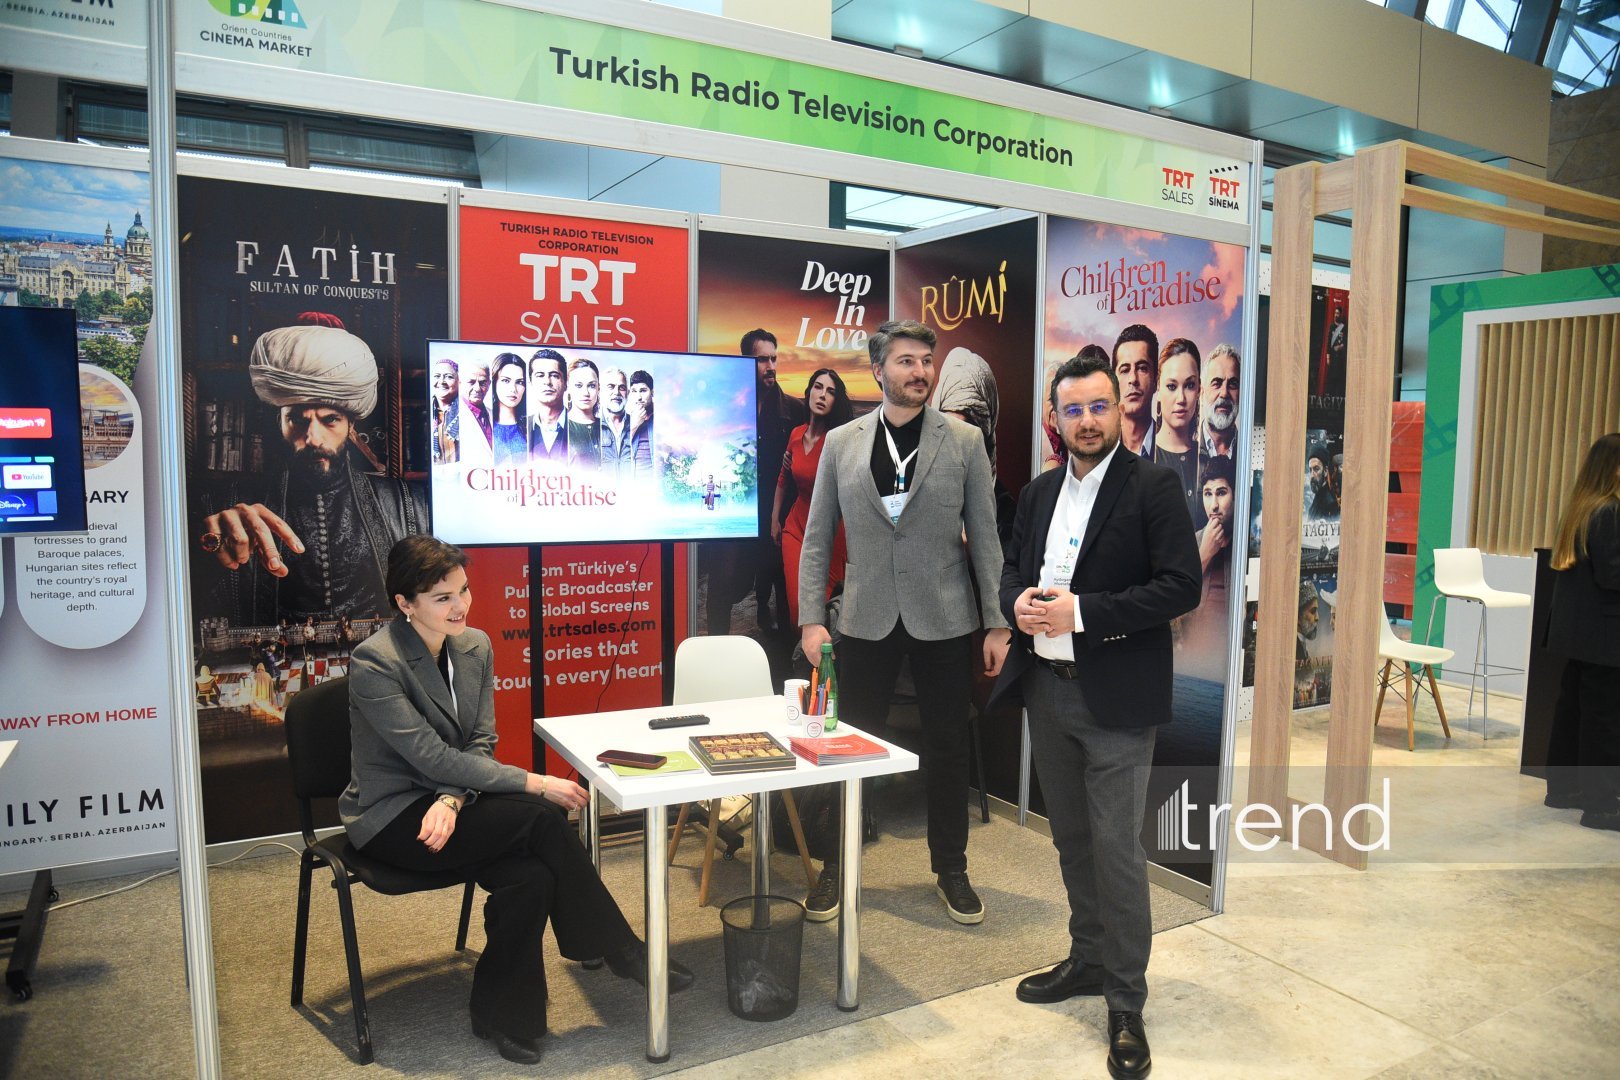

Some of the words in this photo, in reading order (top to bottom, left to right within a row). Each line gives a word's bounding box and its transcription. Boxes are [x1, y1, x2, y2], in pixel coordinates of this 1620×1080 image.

[221, 23, 248, 35] Orient
[251, 28, 292, 41] Countries
[200, 30, 254, 48] CINEMA
[258, 39, 312, 57] MARKET
[549, 46, 679, 94] Turkish
[691, 72, 780, 110] Radio
[788, 90, 925, 137] Television
[933, 119, 1073, 166] Corporation
[1162, 167, 1194, 189] TRT
[1209, 176, 1240, 198] TRT
[1161, 188, 1194, 205] SALES
[500, 222, 550, 236] TURKISH
[553, 227, 588, 239] RADIO
[591, 231, 654, 245] TELEVISION
[538, 239, 619, 255] CORPORATION
[236, 240, 396, 285] FATİH
[519, 252, 637, 306] TRT
[800, 260, 872, 302] Deep
[1061, 257, 1167, 298] Children
[250, 281, 299, 294] SULTAN
[304, 284, 319, 296] OF
[323, 285, 389, 300] CONQUESTS
[1096, 293, 1110, 311] of
[1108, 271, 1221, 314] Paradise
[833, 295, 866, 326] In
[519, 311, 637, 348] SALES
[795, 317, 868, 351] Love
[466, 467, 571, 491] Children
[86, 490, 129, 504] ARY
[520, 484, 617, 507] Paradise
[88, 522, 118, 531] dieval
[34, 535, 84, 545] fortresses
[87, 535, 96, 545] to
[99, 535, 127, 547] grand
[38, 550, 81, 561] Baroque
[84, 548, 125, 560] palaces,
[26, 563, 78, 575] Hungarian
[82, 562, 104, 572] sites
[107, 561, 137, 571] reflect
[522, 563, 563, 578] Fom
[37, 576, 53, 586] the
[103, 575, 128, 587] royal
[505, 584, 554, 599] Puic
[559, 580, 653, 597] Broadcaster
[30, 589, 75, 602] heritage,
[78, 589, 96, 600] and
[99, 587, 135, 598] cultural
[67, 602, 98, 614] depth.
[509, 606, 527, 619] to
[590, 600, 650, 614] Screens
[501, 619, 657, 640] ww.trtsales.com
[522, 643, 593, 663] Sories
[599, 639, 639, 656] that
[556, 669, 610, 685] every
[0, 716, 41, 731] WAY
[47, 711, 100, 727] FROM
[105, 707, 158, 723] HOME
[79, 788, 165, 819] FILM
[98, 822, 166, 836] AZERBAIJAN
